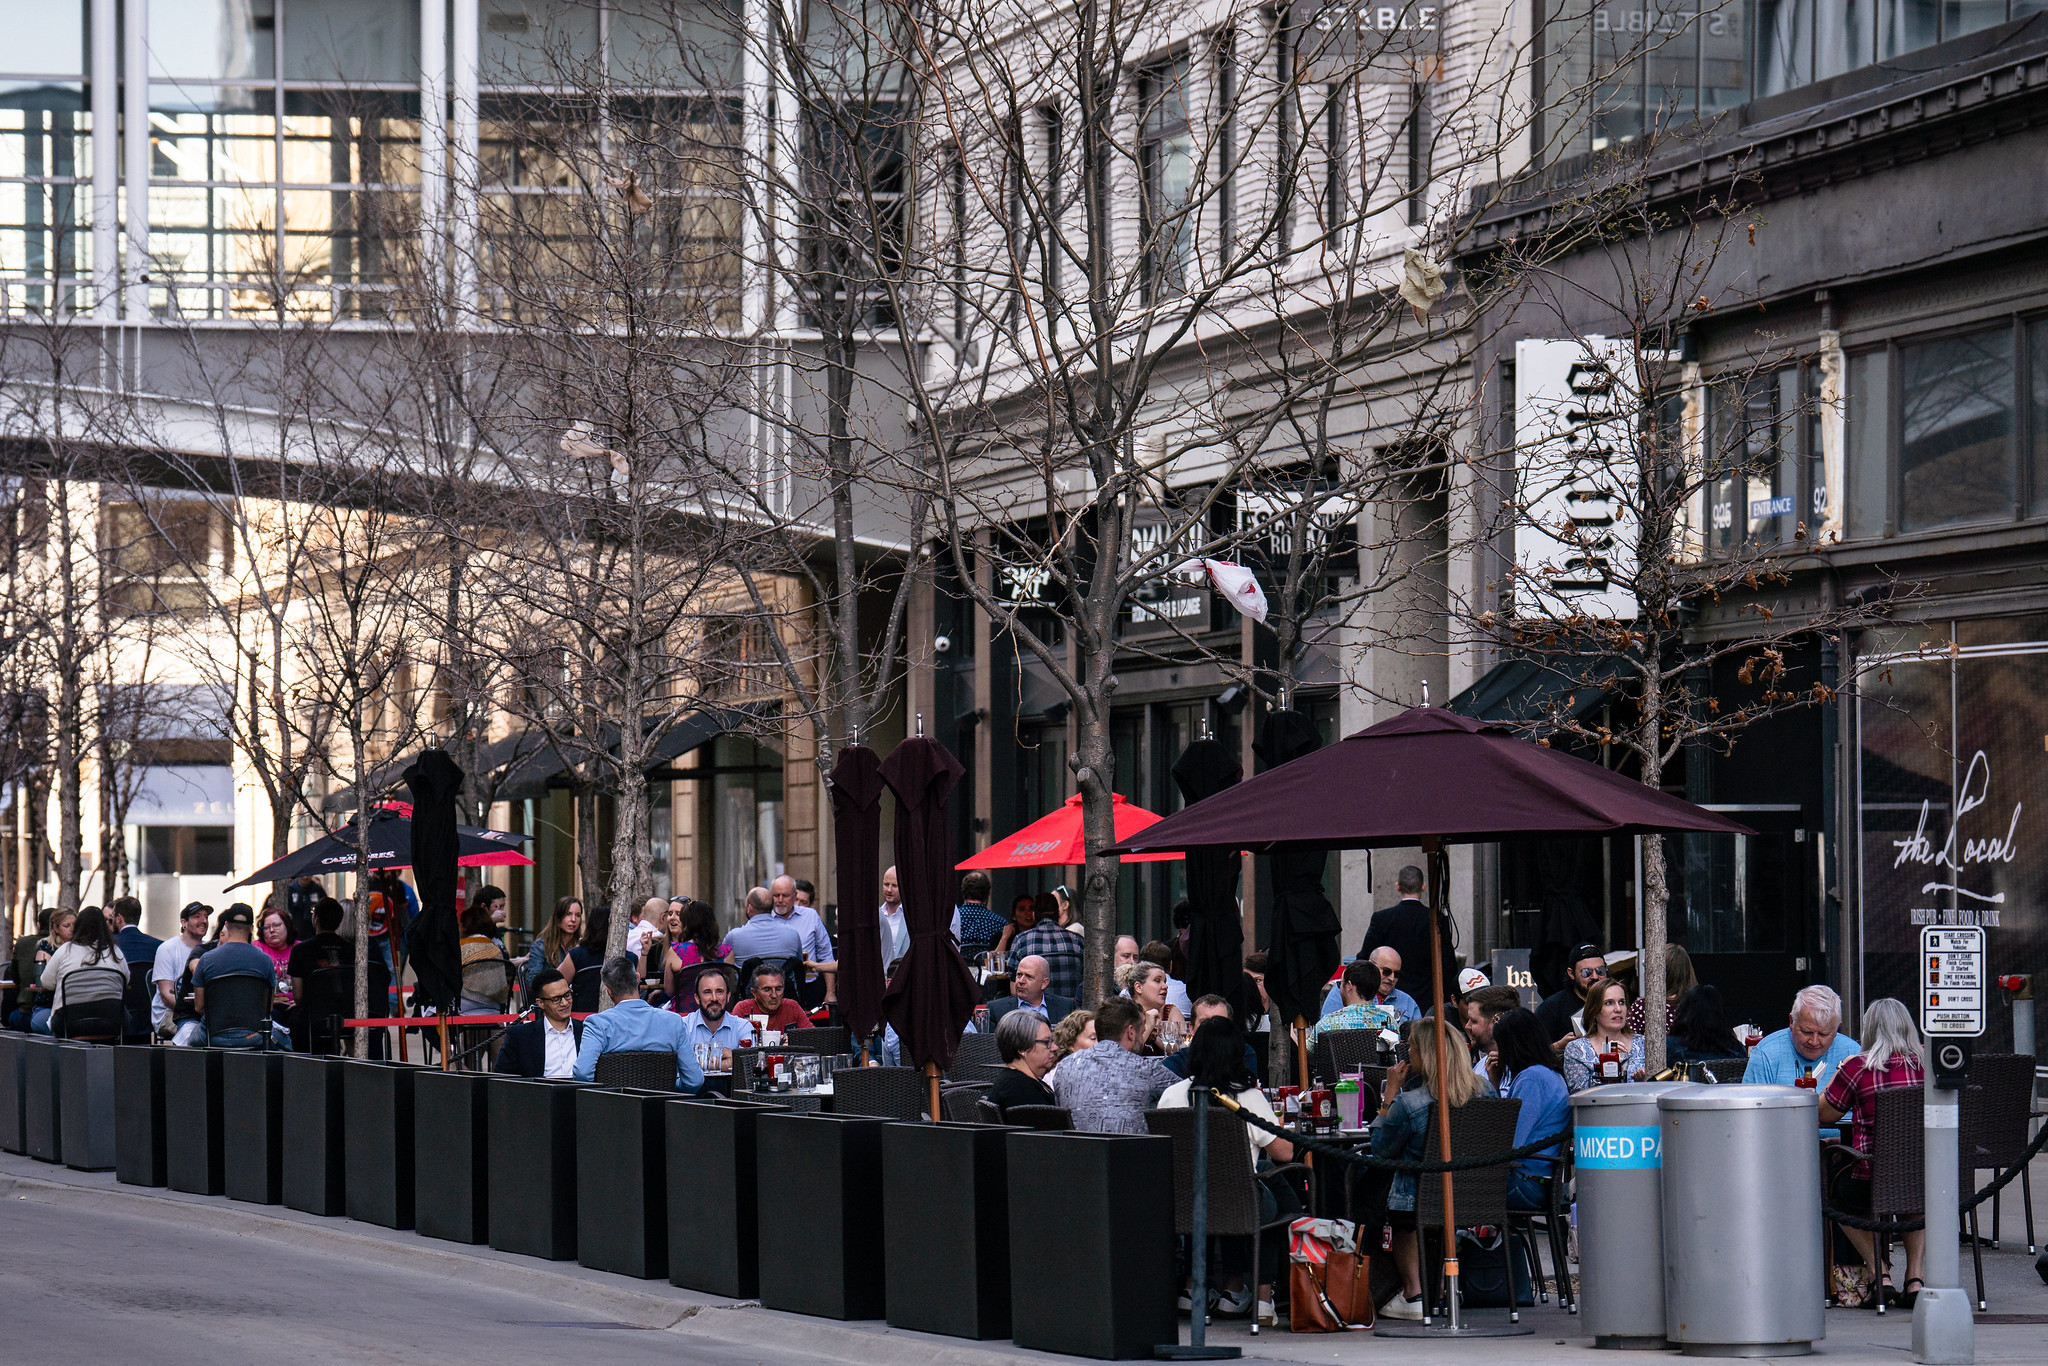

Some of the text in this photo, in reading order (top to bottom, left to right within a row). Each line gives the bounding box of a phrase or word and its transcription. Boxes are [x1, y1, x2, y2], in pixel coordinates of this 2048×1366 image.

[1753, 497, 1791, 516] ENTRANCE
[1893, 749, 2022, 872] the Local
[1010, 840, 1061, 855] 1800
[1958, 910, 1974, 926] FOOD
[1981, 910, 2000, 927] DRINK
[1580, 1137, 1634, 1158] MIXED
